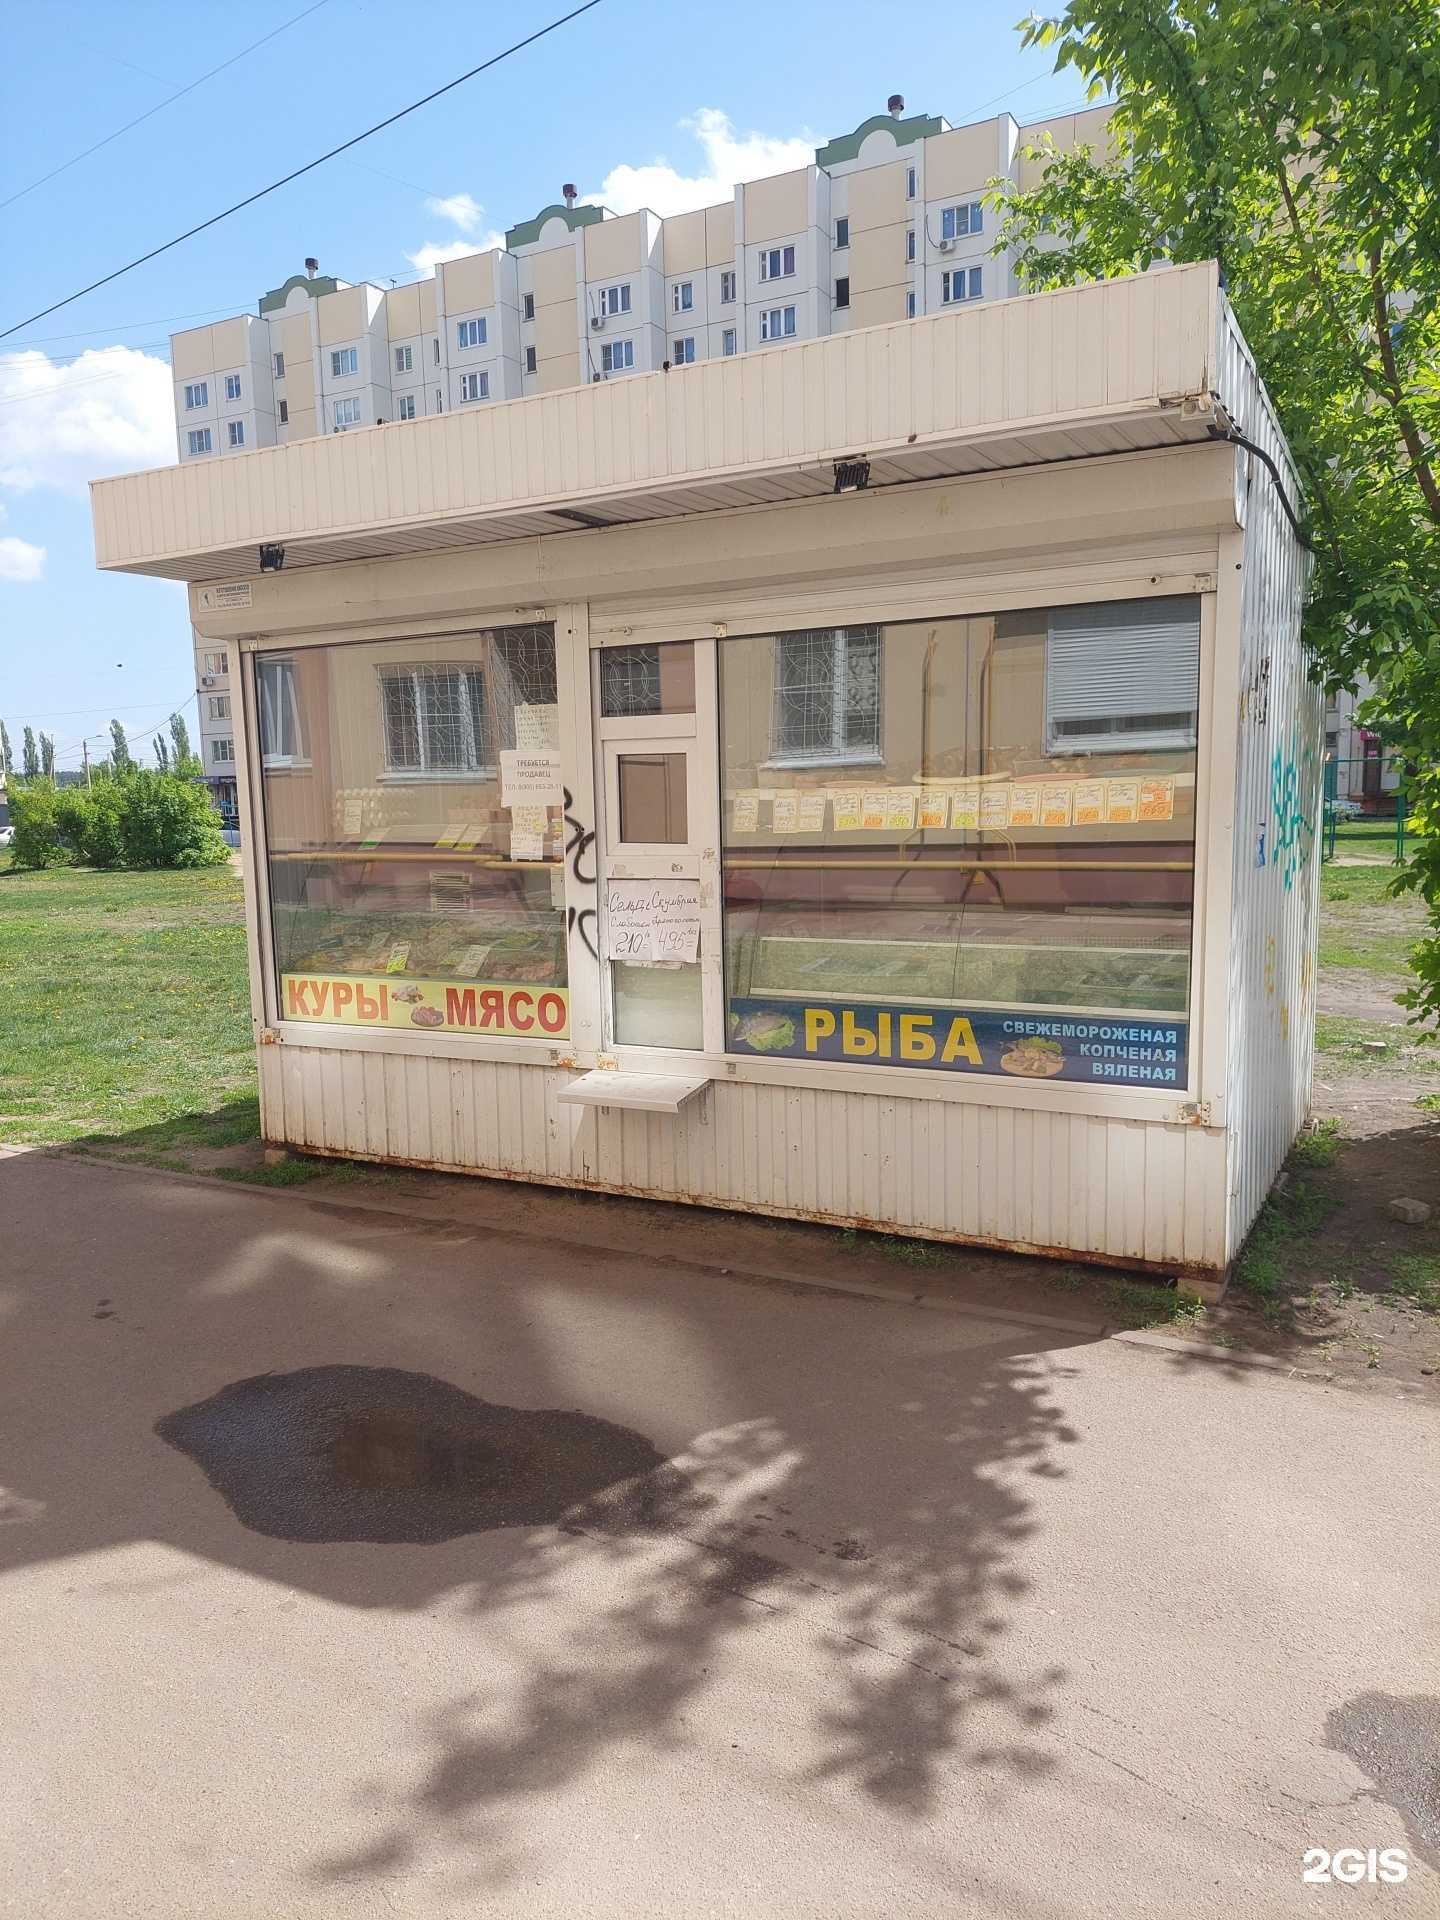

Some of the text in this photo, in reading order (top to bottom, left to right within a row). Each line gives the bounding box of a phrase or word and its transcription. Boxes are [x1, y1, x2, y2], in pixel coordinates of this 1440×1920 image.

[516, 759, 551, 767] ТРЕБУЕТСЯ
[517, 770, 552, 778] ПРОДАВЕЦ
[287, 979, 568, 1033] КУРЫ МЯСО
[804, 1008, 1178, 1066] РЫБА СВЕЖЕМОРОЖЕНАЯ
[1079, 1043, 1178, 1063] КОПЧЕНАЯ
[1091, 1062, 1177, 1081] ВЯЛЕНАЯ
